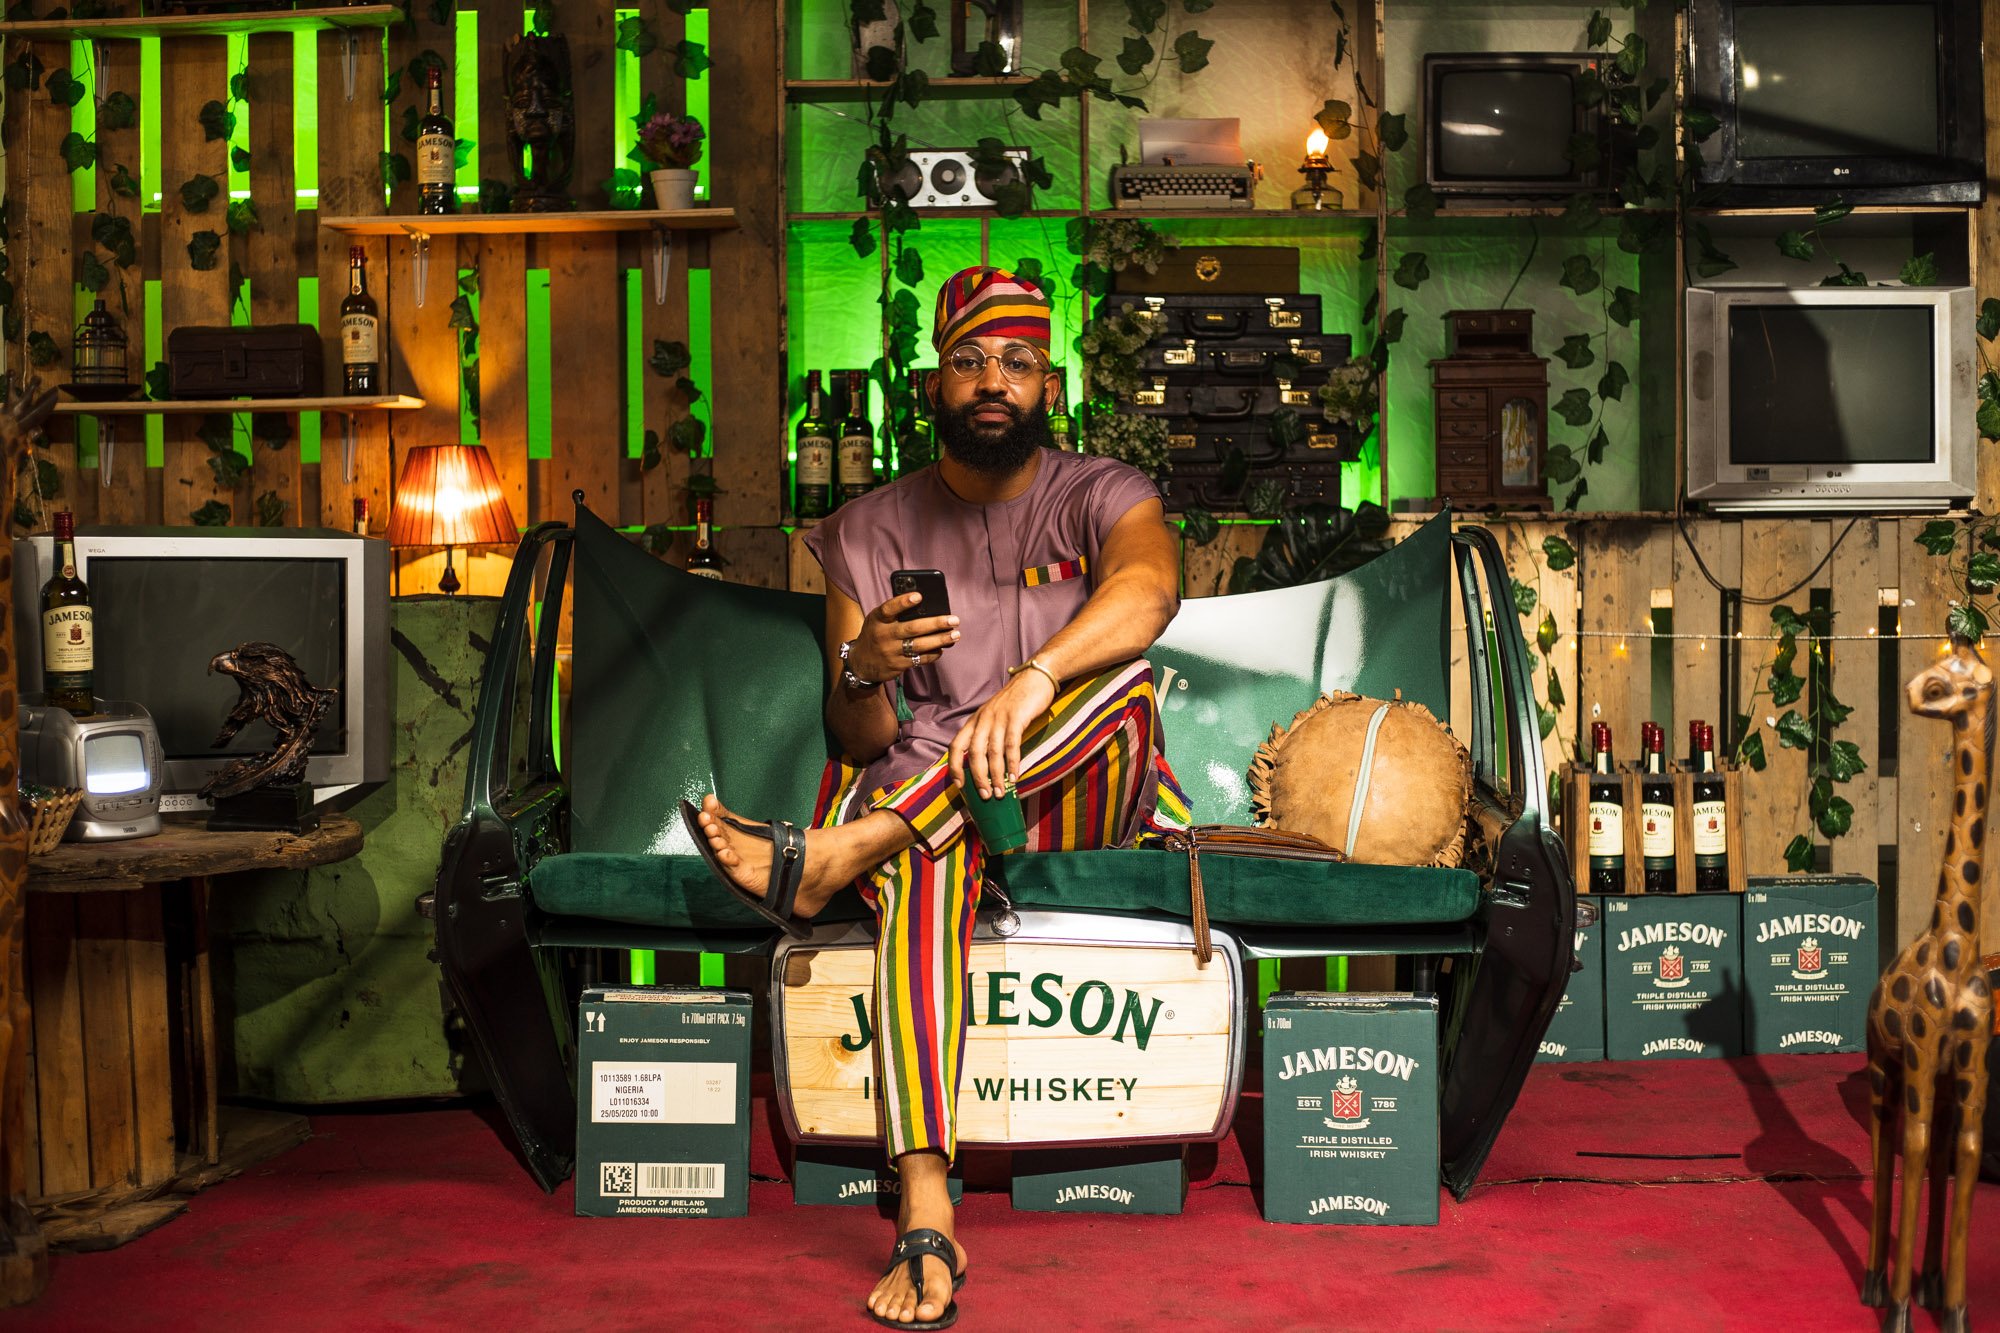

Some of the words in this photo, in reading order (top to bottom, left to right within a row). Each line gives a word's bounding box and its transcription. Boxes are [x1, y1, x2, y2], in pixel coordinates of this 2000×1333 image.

[1756, 913, 1862, 943] JAMESON
[1617, 922, 1724, 952] JAMESON
[1805, 983, 1845, 991] DISTILLED
[1636, 992, 1664, 1000] TRIPLE
[1666, 991, 1708, 999] DISTILLED
[1804, 994, 1840, 1002] WHISKEY
[840, 971, 1165, 1052] JESON
[1642, 1003, 1664, 1011] IRISH
[1666, 1002, 1702, 1010] WHISKEY
[681, 1012, 686, 1024] 6
[690, 1012, 706, 1024] 700ml
[706, 1013, 717, 1024] GIFT
[717, 1013, 730, 1025] PACK
[731, 1013, 746, 1027] 7.5kg
[1276, 1017, 1291, 1029] 700ml
[1779, 1030, 1841, 1048] JAMESON
[1642, 1037, 1704, 1056] JAMESON
[1278, 1046, 1415, 1081] JAMESON
[600, 1074, 632, 1083] 10113589
[634, 1073, 662, 1082] 1.68LPA
[615, 1085, 644, 1094] NIGERIA
[973, 1077, 1138, 1101] WHISKEY
[1373, 1100, 1395, 1108] 1780
[600, 1109, 638, 1118] 25/05/2020
[640, 1109, 659, 1118] 10:00
[1302, 1136, 1338, 1144] TRIPLE
[1341, 1136, 1392, 1145] DISTILLED
[1309, 1150, 1337, 1158] IRISH
[1340, 1150, 1386, 1158] WHISKEY
[838, 1179, 902, 1198] JAMESO
[1055, 1184, 1132, 1205] JAMESON
[1308, 1195, 1387, 1216] JAMESON
